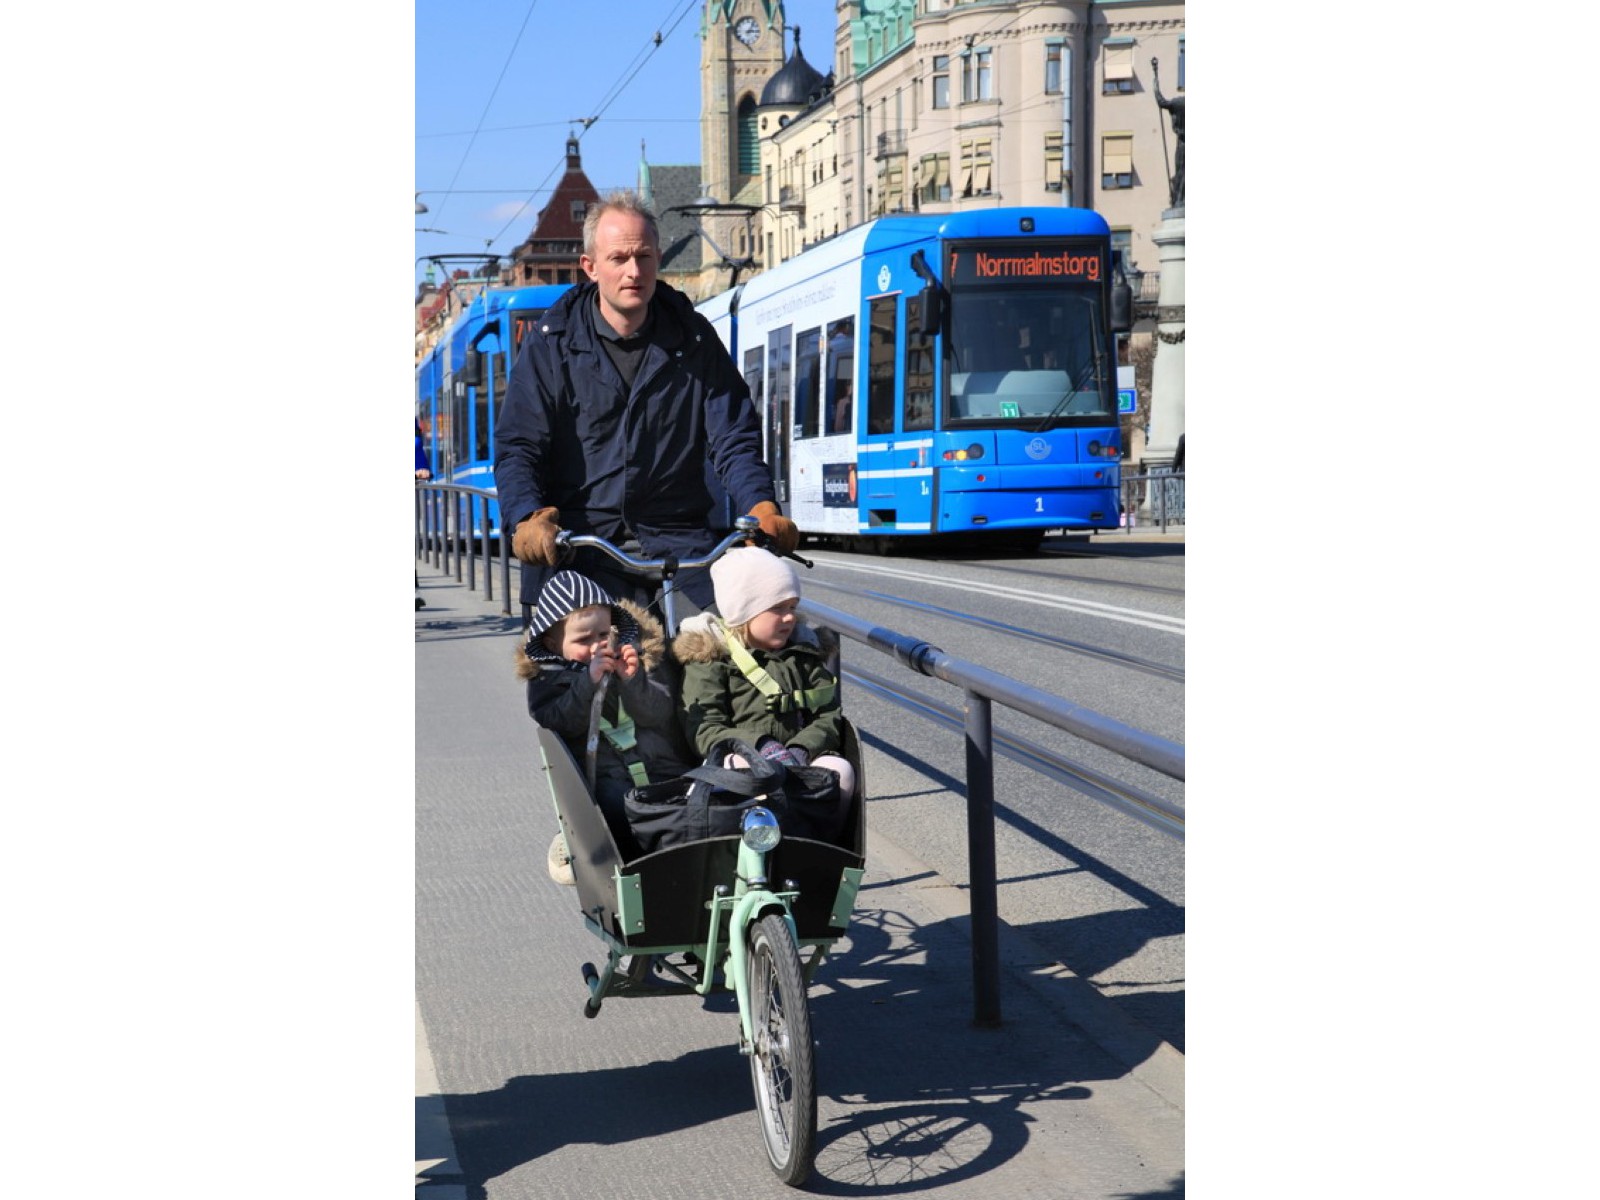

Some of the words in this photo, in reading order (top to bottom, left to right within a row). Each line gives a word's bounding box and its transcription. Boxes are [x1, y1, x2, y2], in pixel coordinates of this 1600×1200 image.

[951, 253, 958, 278] 7
[976, 251, 1099, 281] Norrmalmstorg
[516, 319, 524, 343] 7
[1035, 497, 1044, 512] 1
